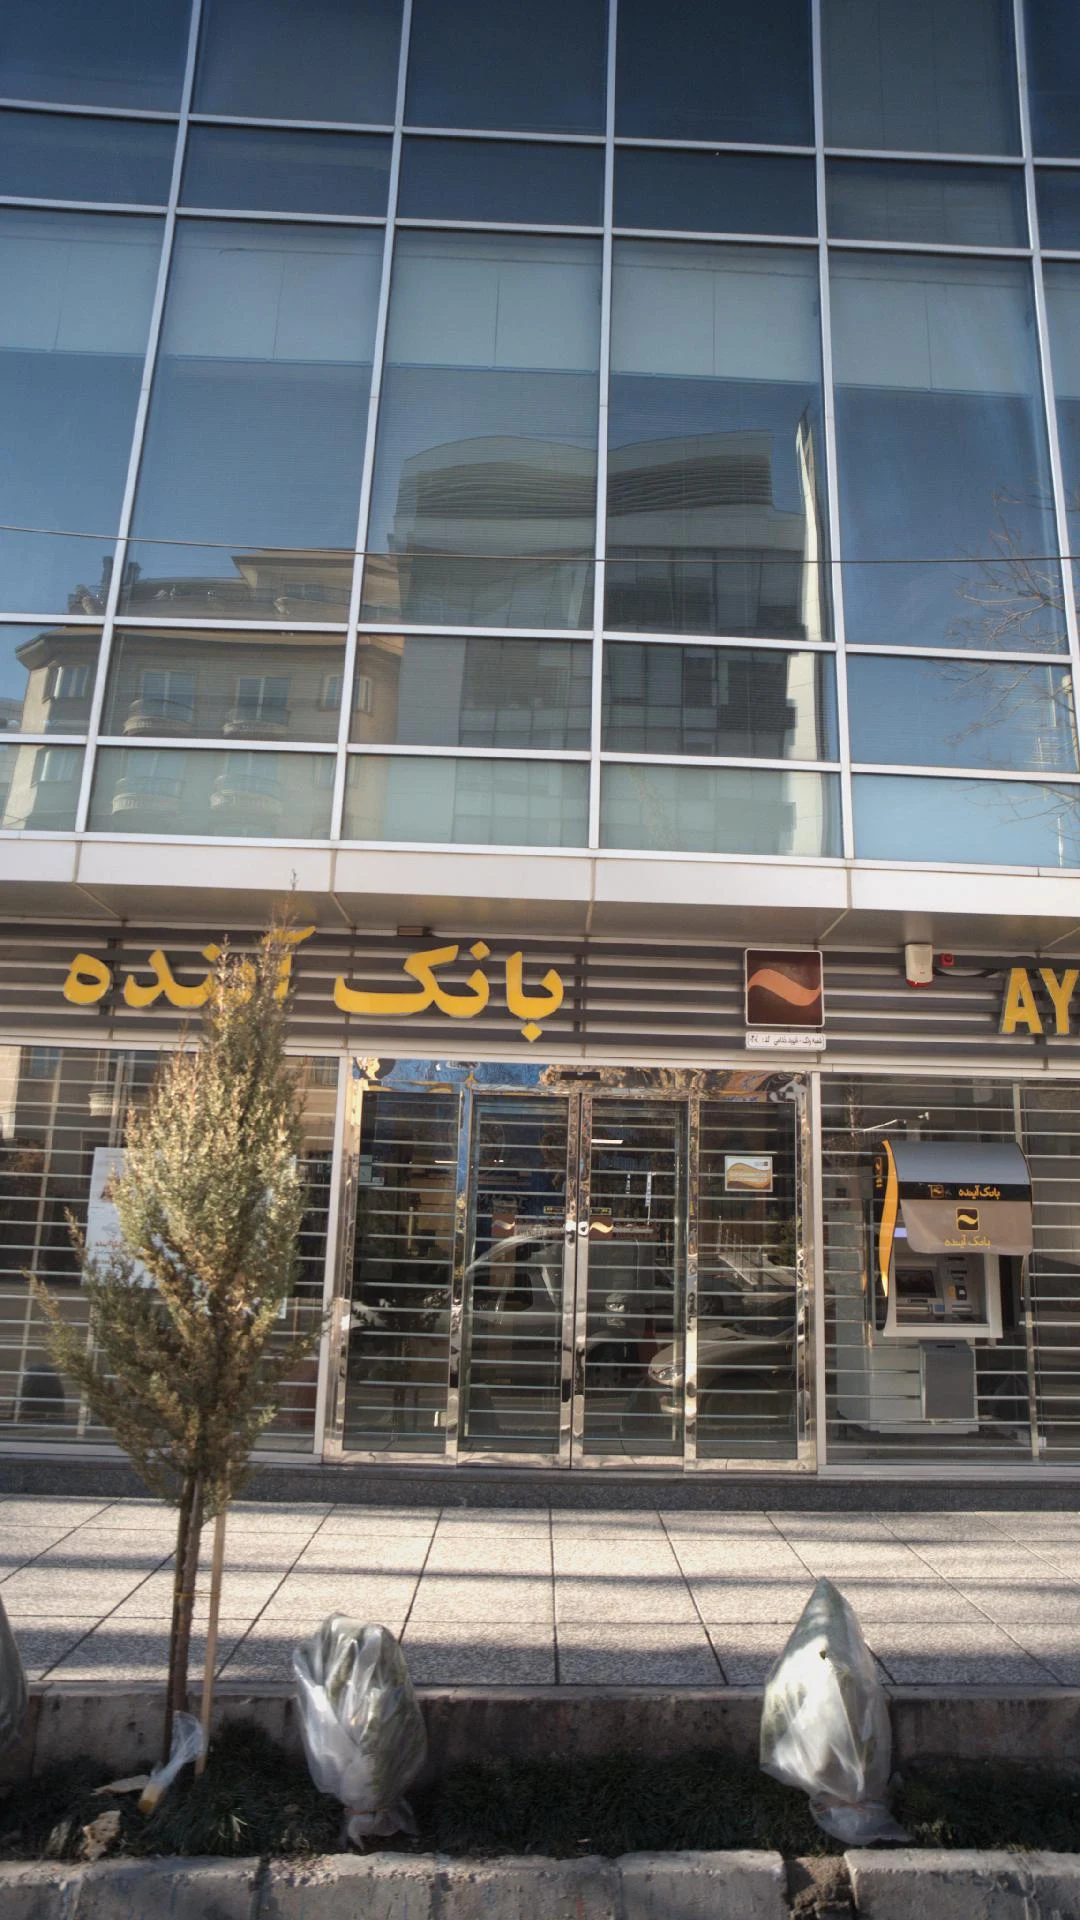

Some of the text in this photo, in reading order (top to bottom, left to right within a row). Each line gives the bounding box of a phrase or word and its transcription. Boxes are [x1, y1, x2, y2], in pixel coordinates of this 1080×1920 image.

[334, 941, 563, 1042] بانک
[1001, 967, 1080, 1035] AY
[959, 1184, 1001, 1200] بانک آینده
